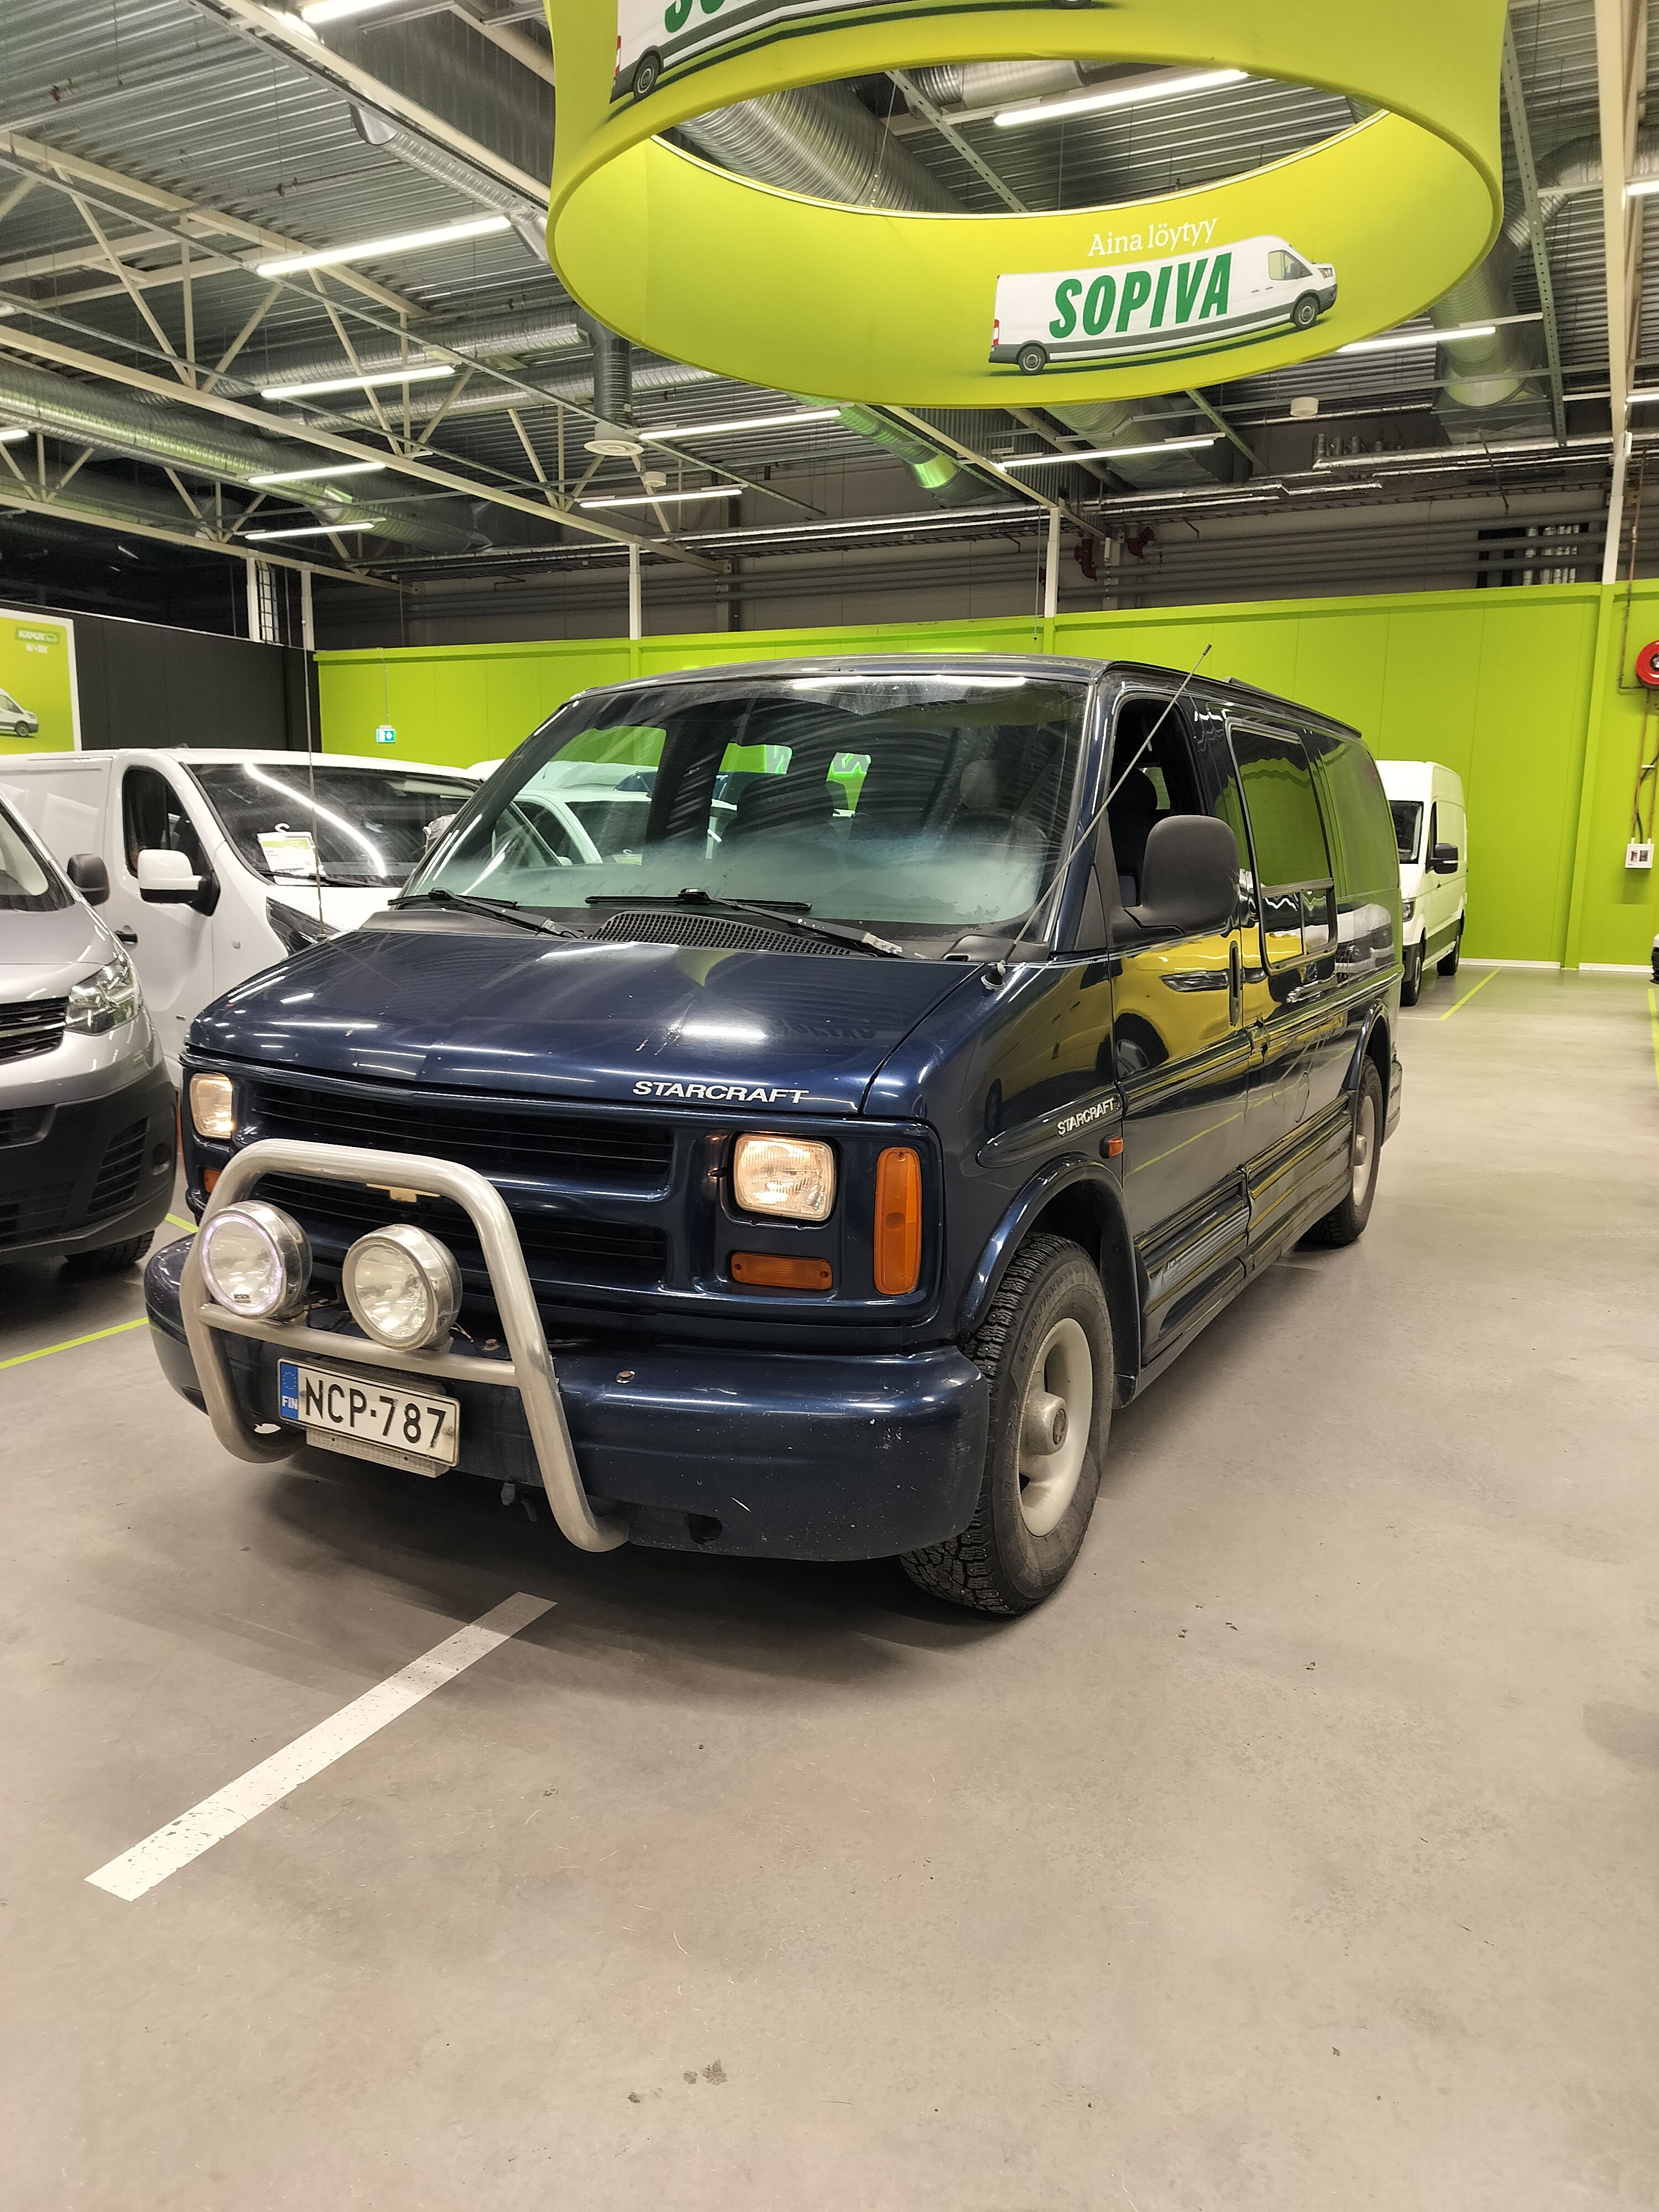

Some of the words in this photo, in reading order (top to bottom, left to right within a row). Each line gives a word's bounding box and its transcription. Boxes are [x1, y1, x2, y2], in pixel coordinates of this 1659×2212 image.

[1087, 231, 1143, 257] Aina
[1147, 217, 1218, 251] löytyy
[1049, 252, 1232, 338] SOPIVA
[633, 1081, 809, 1103] STARCRAFT
[1057, 1098, 1114, 1135] STARCRAFT
[282, 1395, 299, 1410] FIN
[305, 1376, 447, 1449] NCP-787
